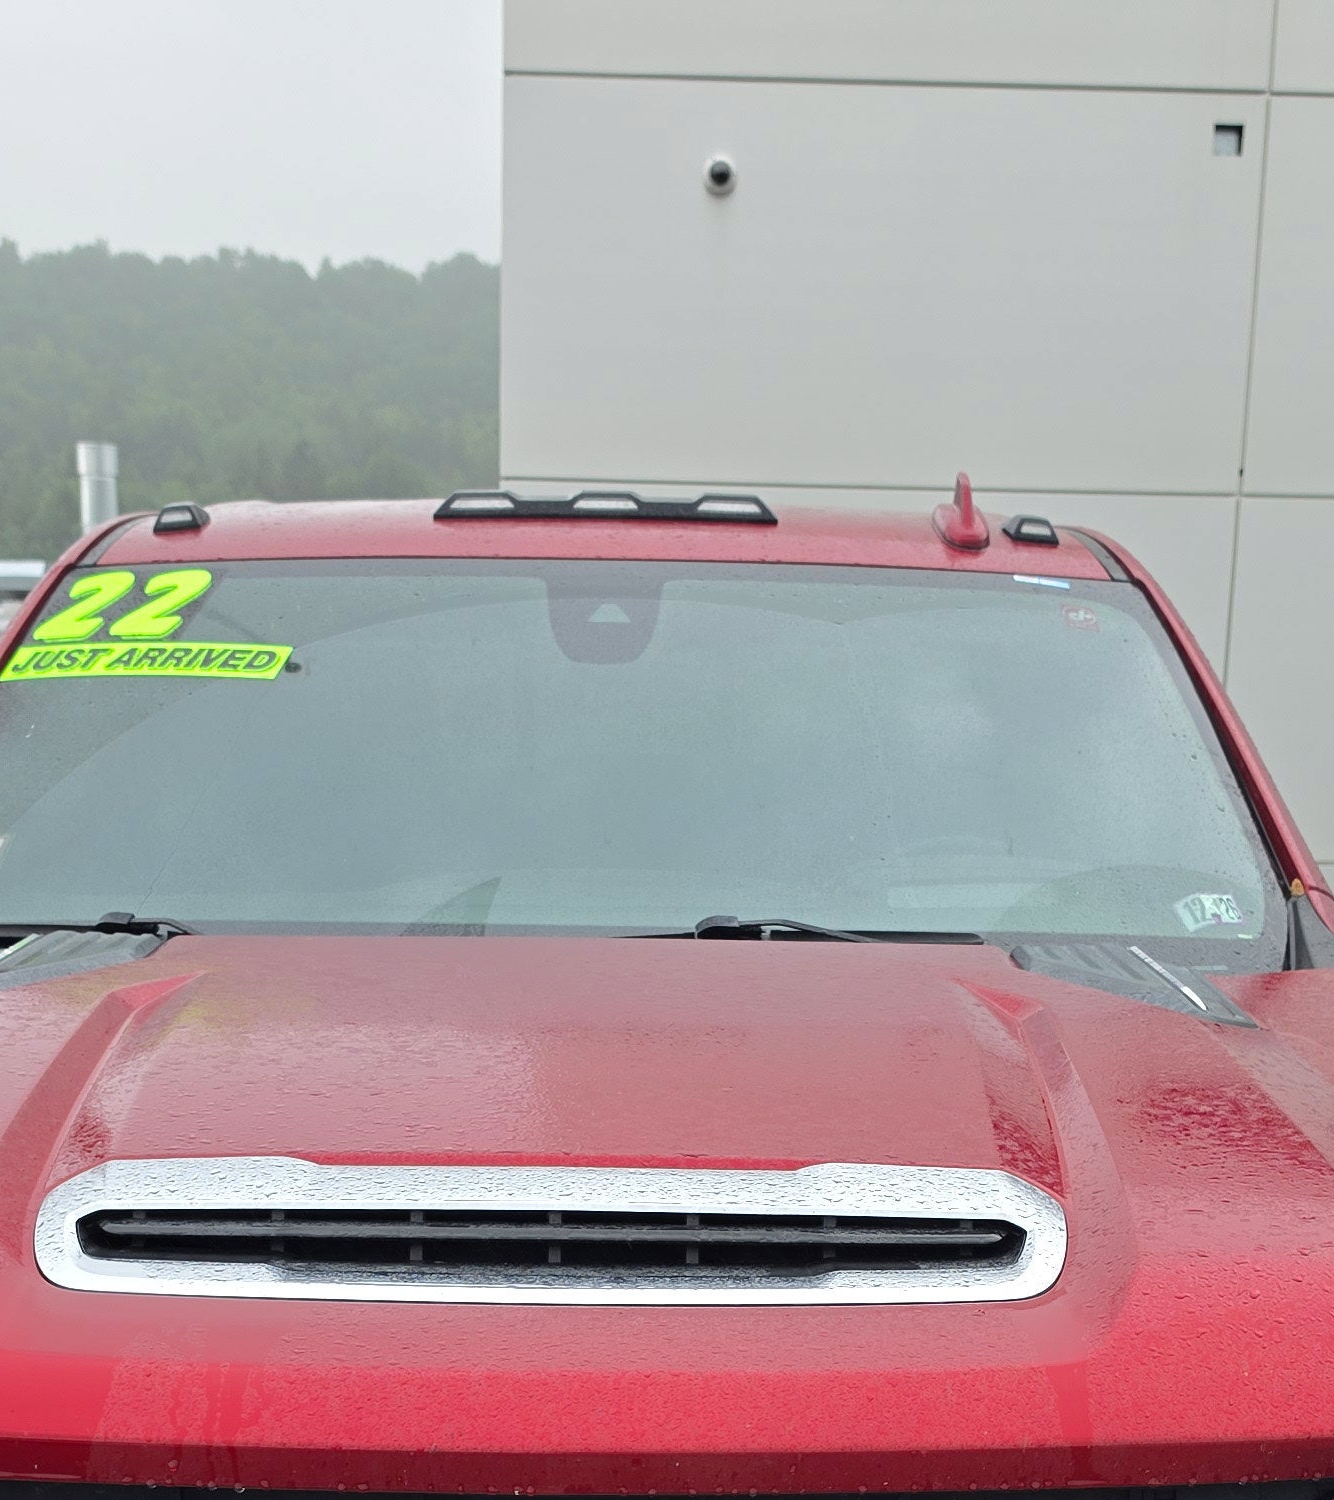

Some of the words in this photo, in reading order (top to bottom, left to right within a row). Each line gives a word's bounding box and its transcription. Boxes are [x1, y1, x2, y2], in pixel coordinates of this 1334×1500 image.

[33, 569, 213, 642] 22
[12, 648, 112, 673] JUST
[106, 647, 282, 673] ARRIVED
